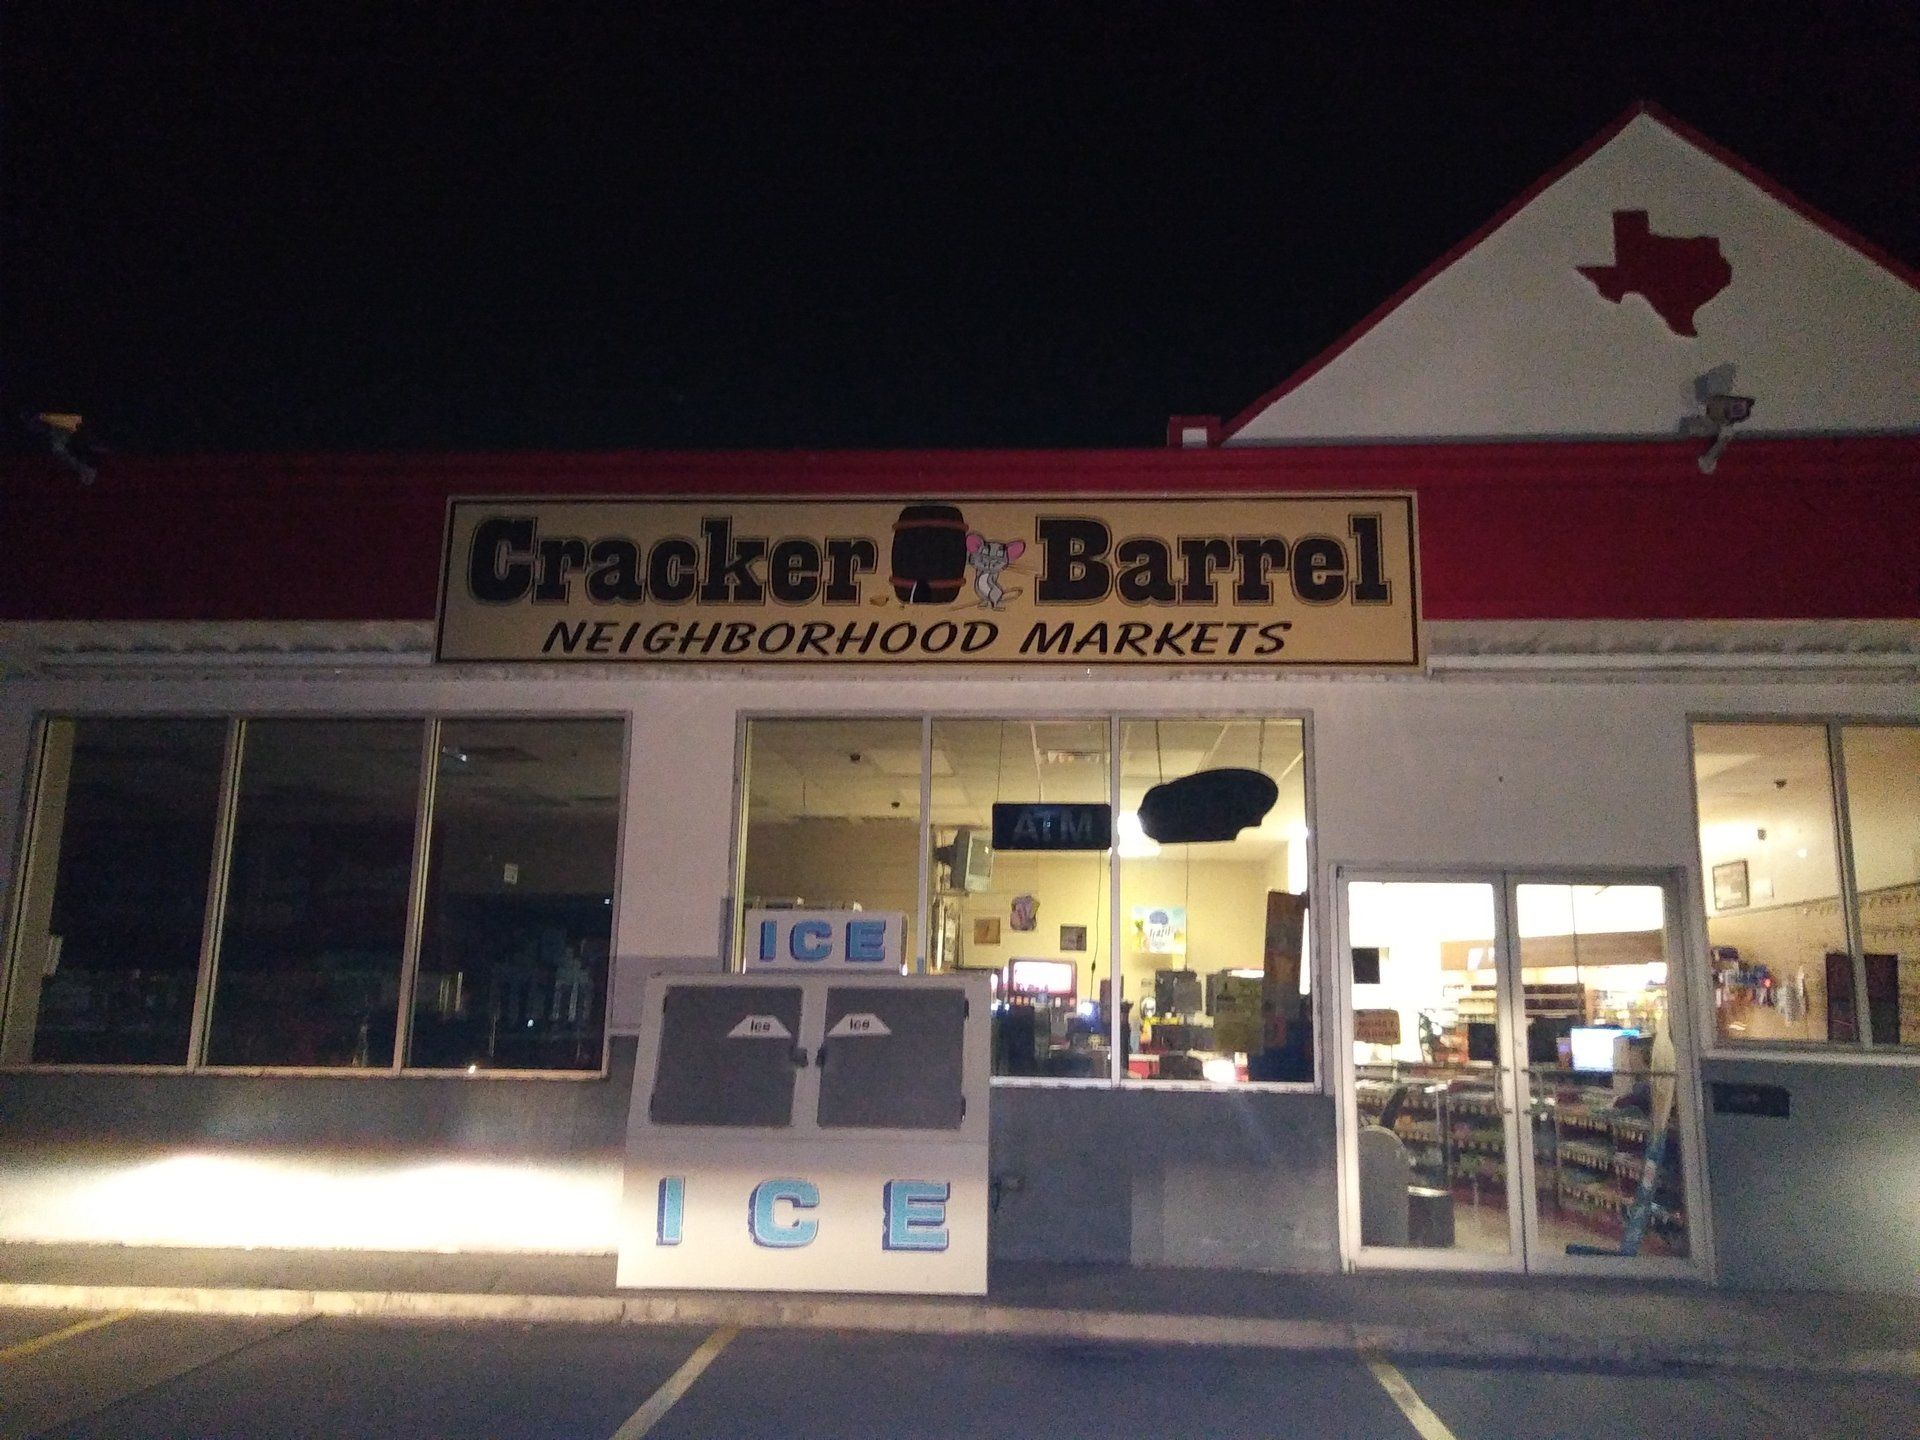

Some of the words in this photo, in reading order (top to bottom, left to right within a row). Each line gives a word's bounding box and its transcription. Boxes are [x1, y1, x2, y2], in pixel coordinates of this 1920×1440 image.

[468, 515, 877, 606] Cracker
[1035, 513, 1393, 606] Barrel
[541, 621, 998, 655] NEIGHBORHOOD
[1018, 620, 1292, 656] MARKETS
[1011, 809, 1093, 843] ATM
[759, 919, 887, 962] ICE
[656, 1176, 950, 1251] ICE
